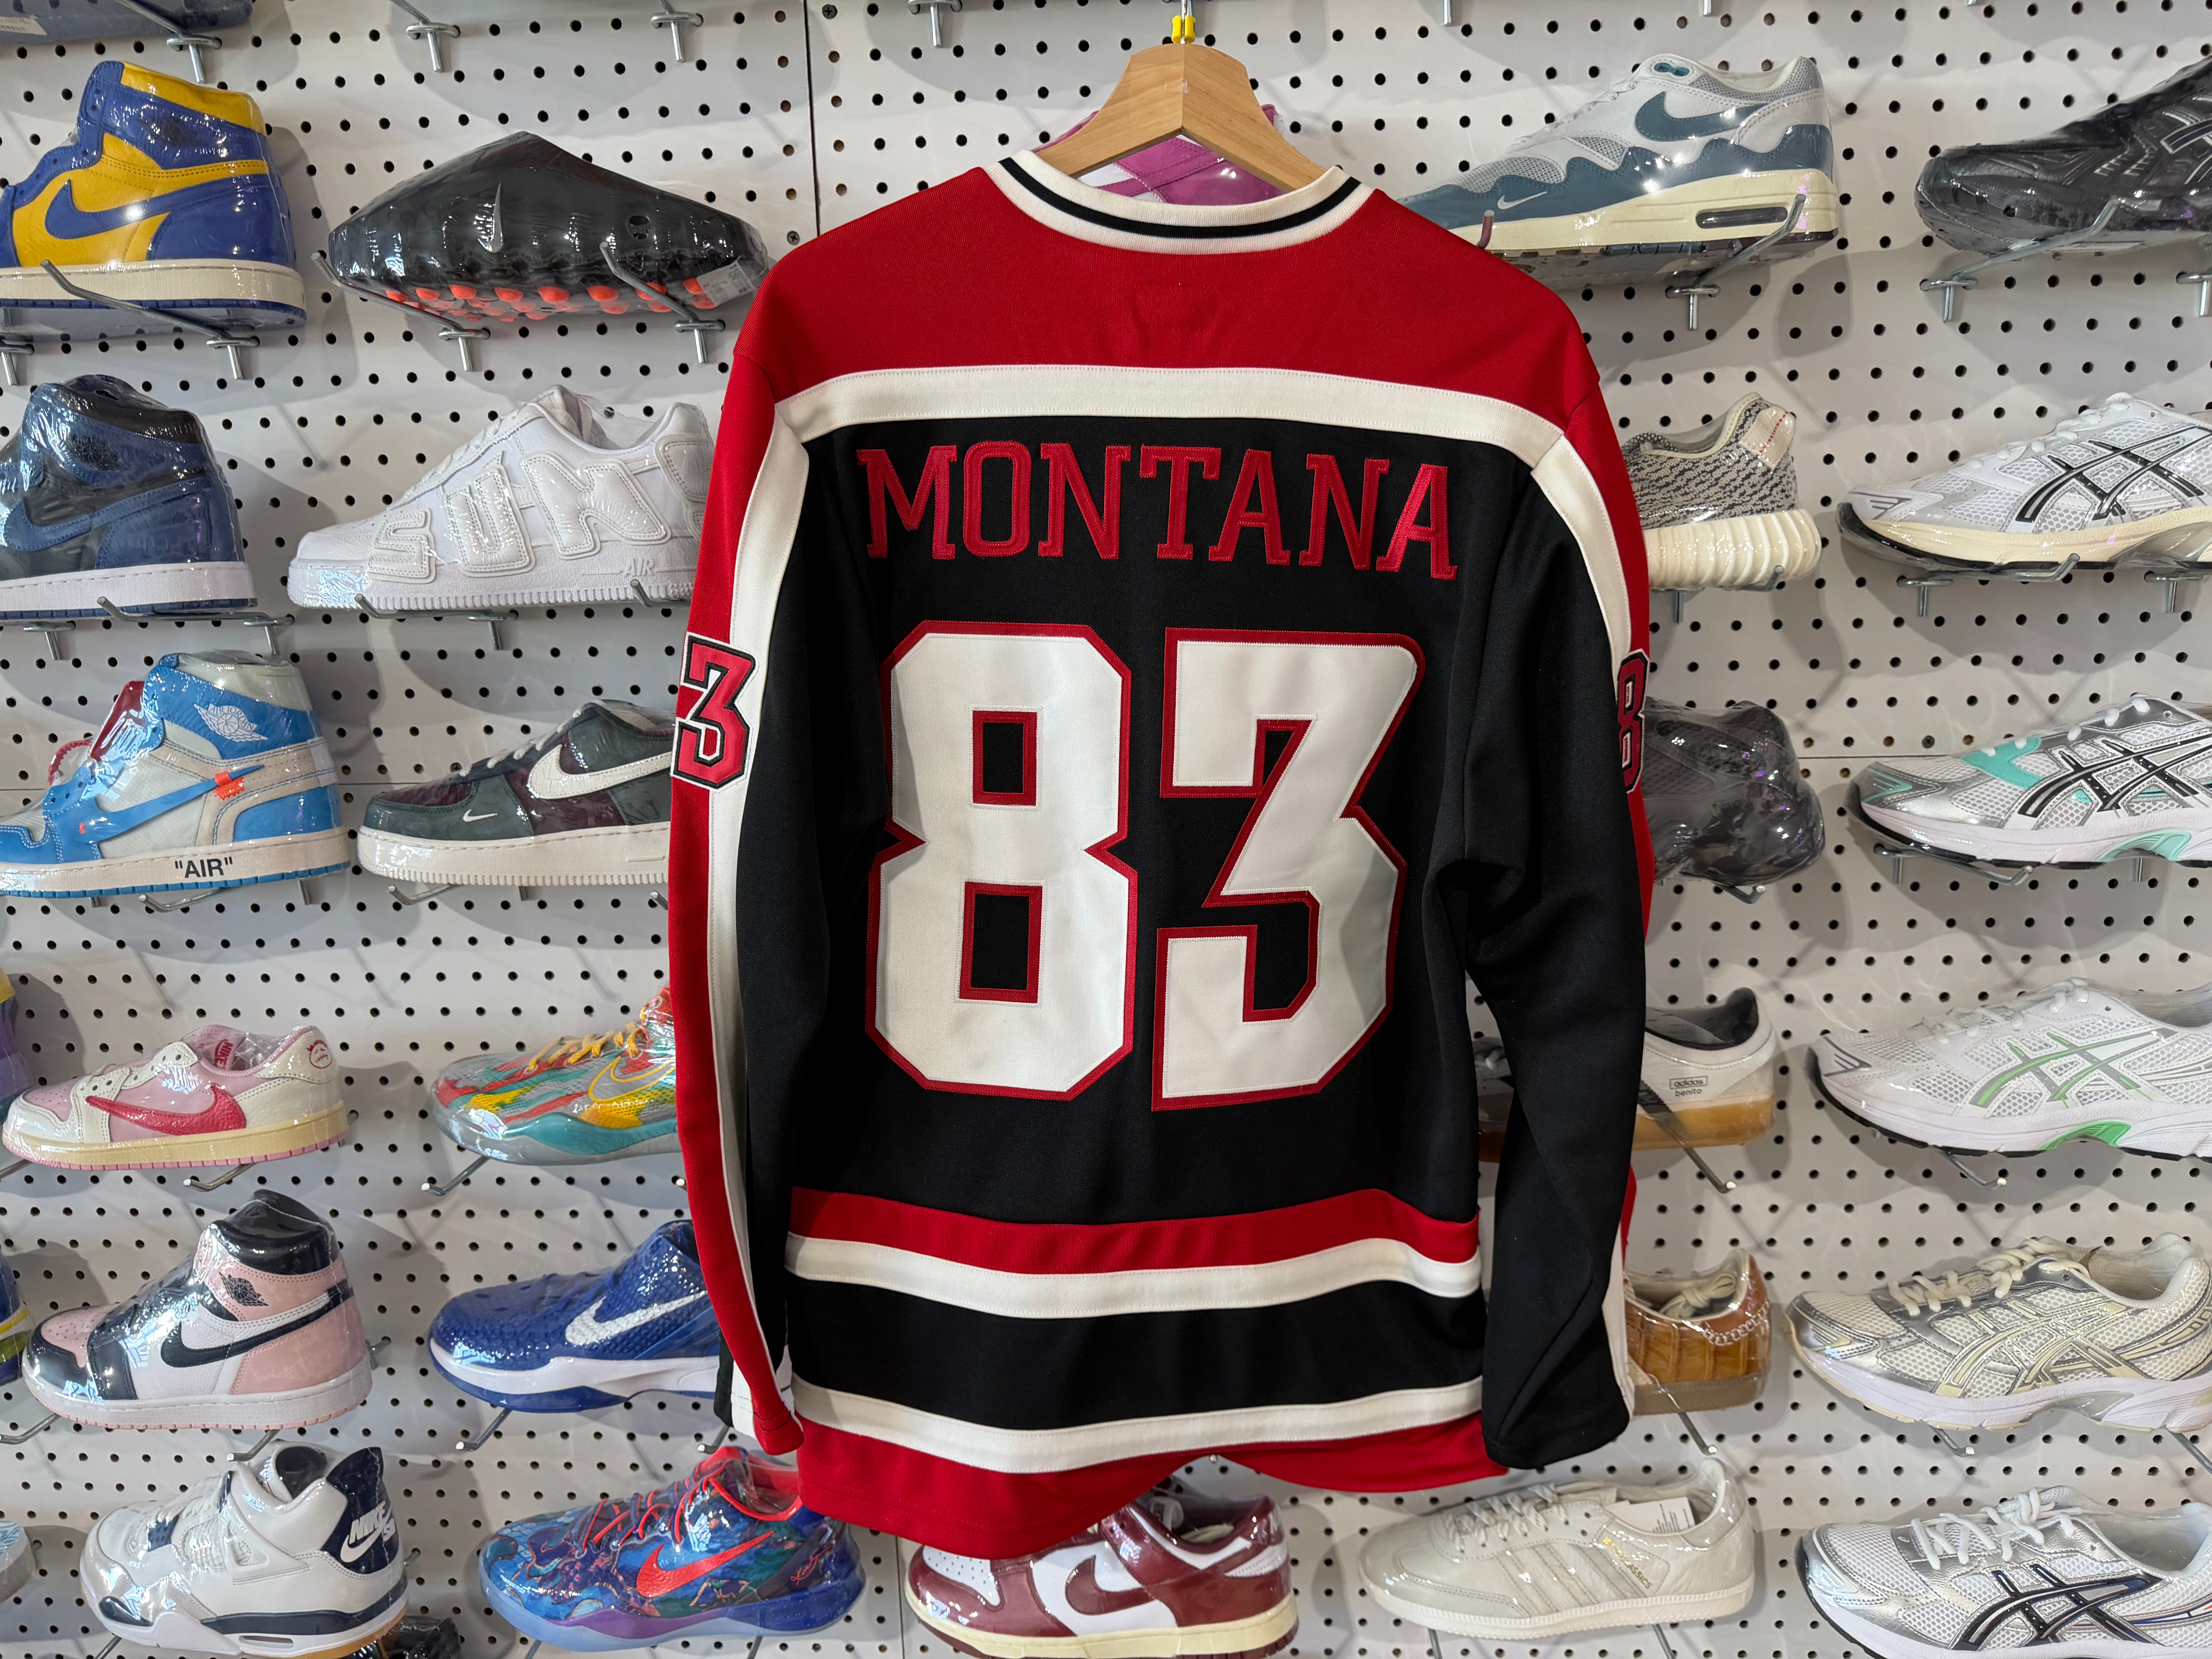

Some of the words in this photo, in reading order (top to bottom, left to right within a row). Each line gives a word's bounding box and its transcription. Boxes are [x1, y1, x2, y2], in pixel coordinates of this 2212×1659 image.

[857, 441, 1458, 580] MONTANA
[623, 556, 655, 577] AIR
[227, 705, 254, 731] JORDAN
[670, 632, 759, 793] 3
[1617, 649, 1650, 794] 8
[175, 857, 233, 878] "AIR"
[865, 620, 1425, 1111] 83
[216, 1041, 234, 1066] NIKE
[1673, 1079, 1704, 1087] adidas
[1675, 1089, 1702, 1097] benito
[349, 1500, 386, 1544] NIKE
[383, 1518, 396, 1542] SB
[1620, 1554, 1652, 1589] ASSICS
